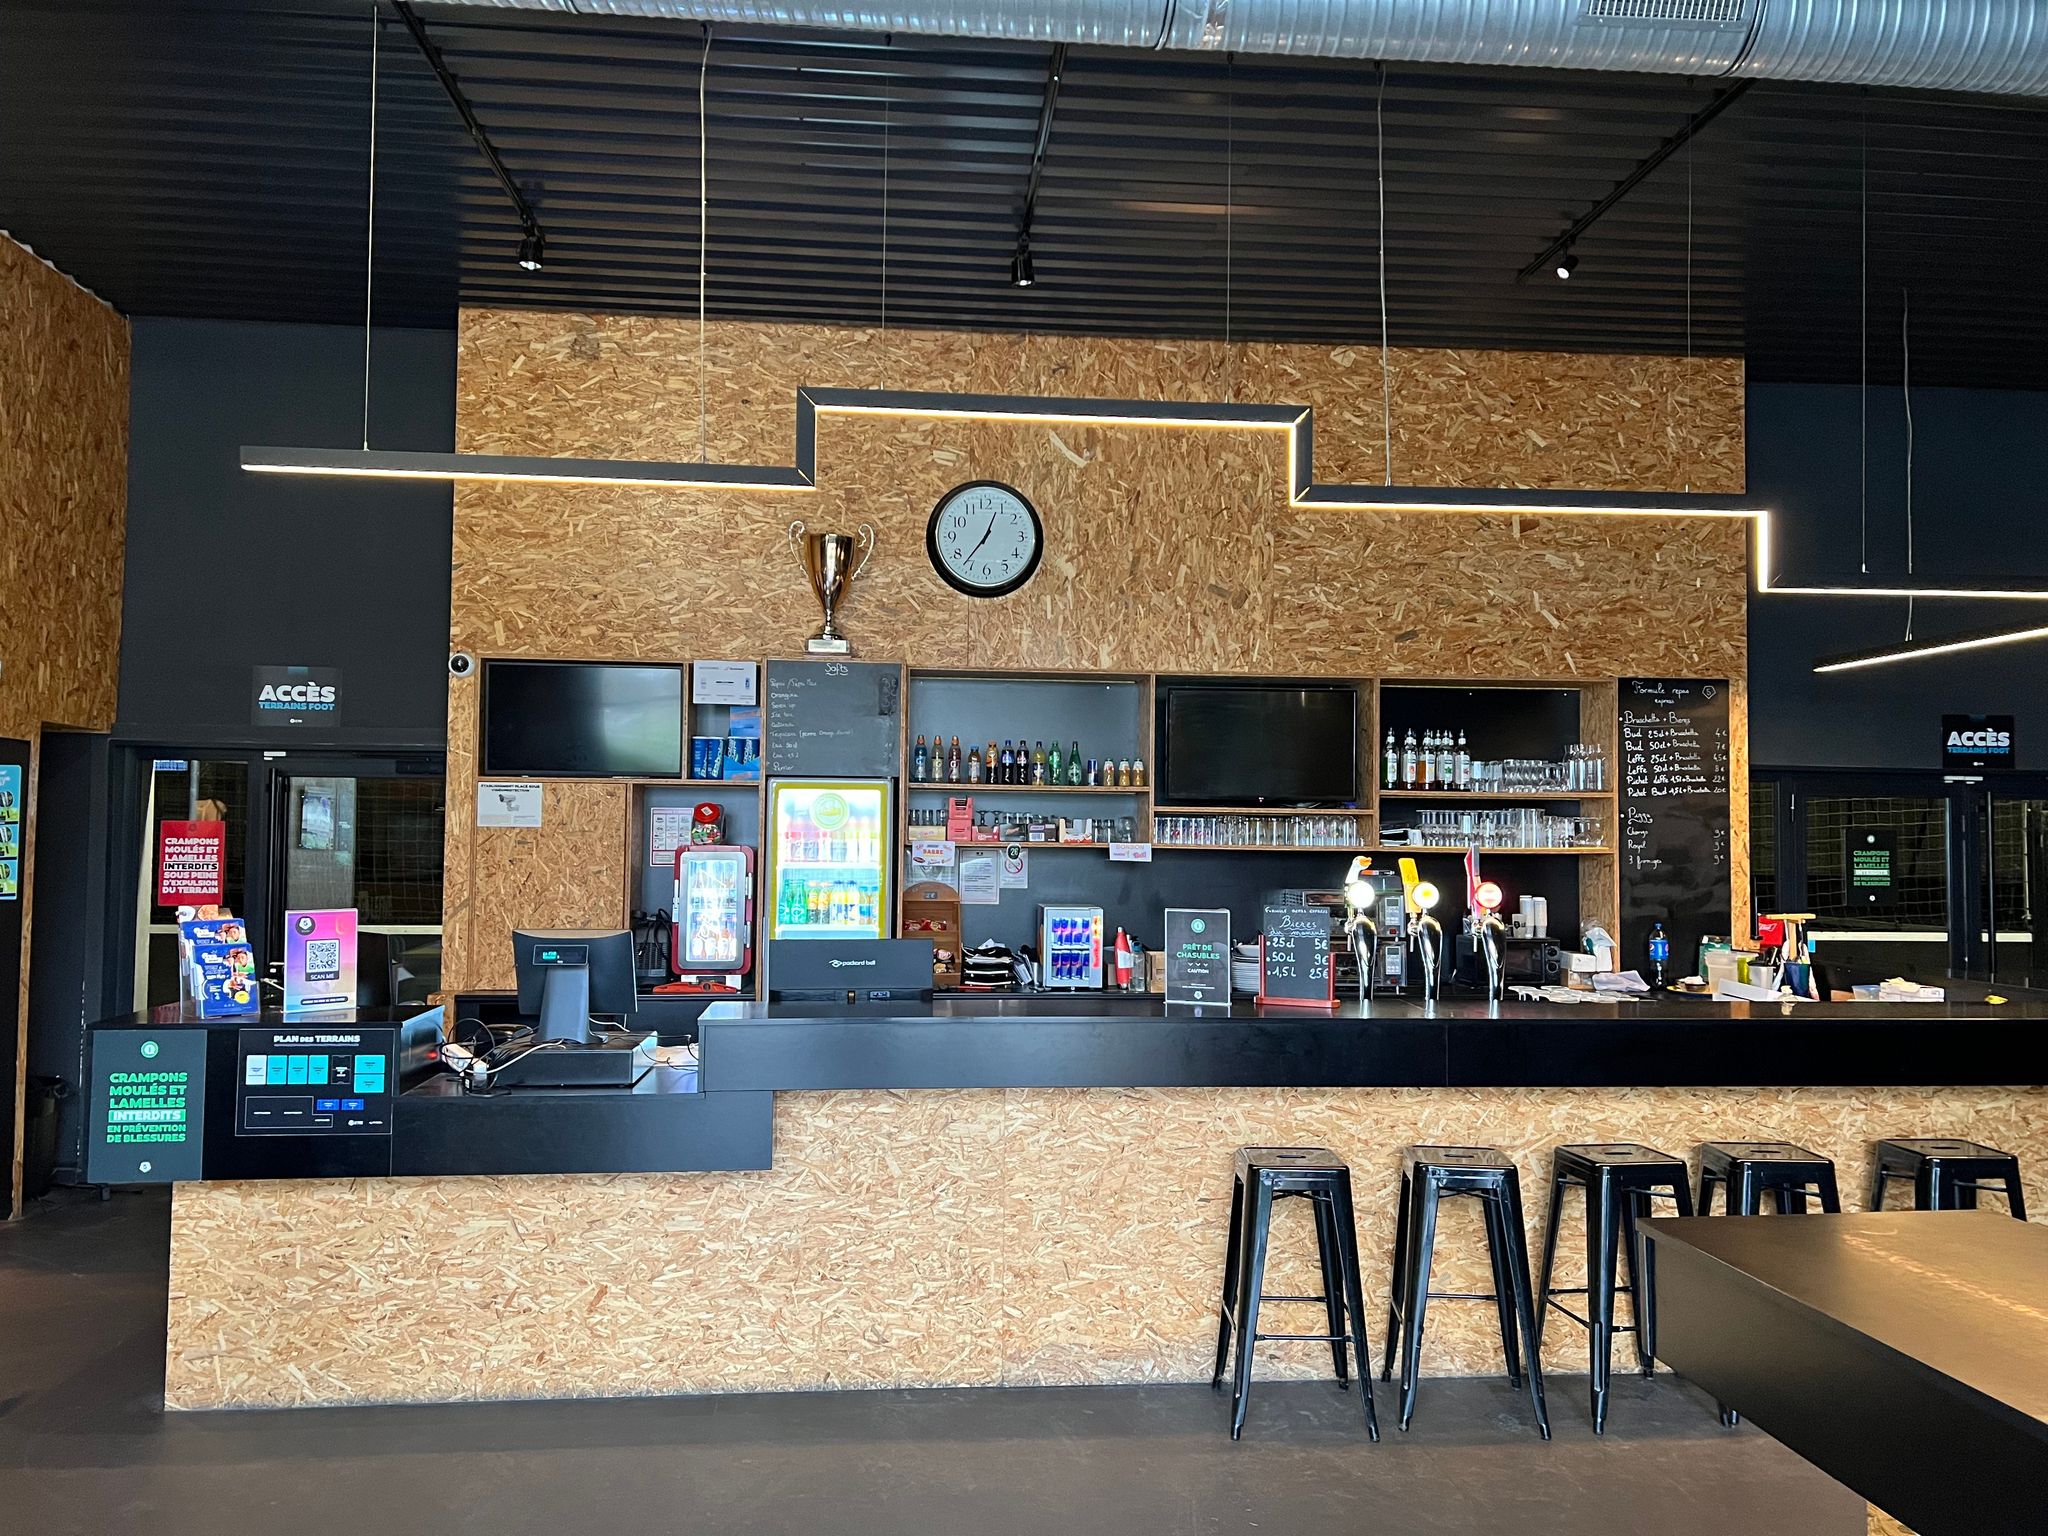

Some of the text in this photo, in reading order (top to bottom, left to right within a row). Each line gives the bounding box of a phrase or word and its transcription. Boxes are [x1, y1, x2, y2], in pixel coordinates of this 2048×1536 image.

[965, 503, 975, 515] 11
[979, 498, 993, 510] 12
[1000, 503, 1004, 514] 1
[953, 516, 966, 528] 10
[1010, 513, 1018, 525] 2
[948, 531, 956, 543] 9
[1018, 531, 1025, 542] 3
[953, 548, 962, 559] 8
[1011, 547, 1019, 558] 4
[967, 560, 975, 571] 7
[982, 564, 991, 576] 6
[1001, 559, 1009, 572] 5
[824, 663, 849, 675] Softs
[258, 681, 336, 703] ACCÈS
[258, 702, 335, 711] TERRAINS FOOT
[1624, 727, 1643, 738] Bud
[1947, 727, 2010, 747] ACCÈS
[1625, 740, 1644, 751] Bud
[1947, 746, 1987, 754] TERRAINS
[1627, 765, 1648, 775] Leffe
[165, 837, 219, 845] CRAMPONS
[165, 845, 205, 853] MOULÉS
[163, 871, 190, 879] SOUS
[1182, 943, 1201, 951] PRÊT
[1314, 938, 1328, 950] 5€
[1176, 951, 1220, 960] CHASUBLES
[1314, 953, 1329, 965] 9€
[1308, 968, 1329, 979] 25€
[273, 1035, 298, 1043] PLAN
[315, 1035, 361, 1043] TERRAINS
[109, 1072, 188, 1083] CRAMPONS
[109, 1083, 187, 1096] MOULÉS ET
[109, 1097, 186, 1109] LAMELLES
[113, 1110, 180, 1120] INTERDITS
[107, 1123, 187, 1133] EN PRÉVENTION
[106, 1133, 186, 1143] DE BLESSURES
